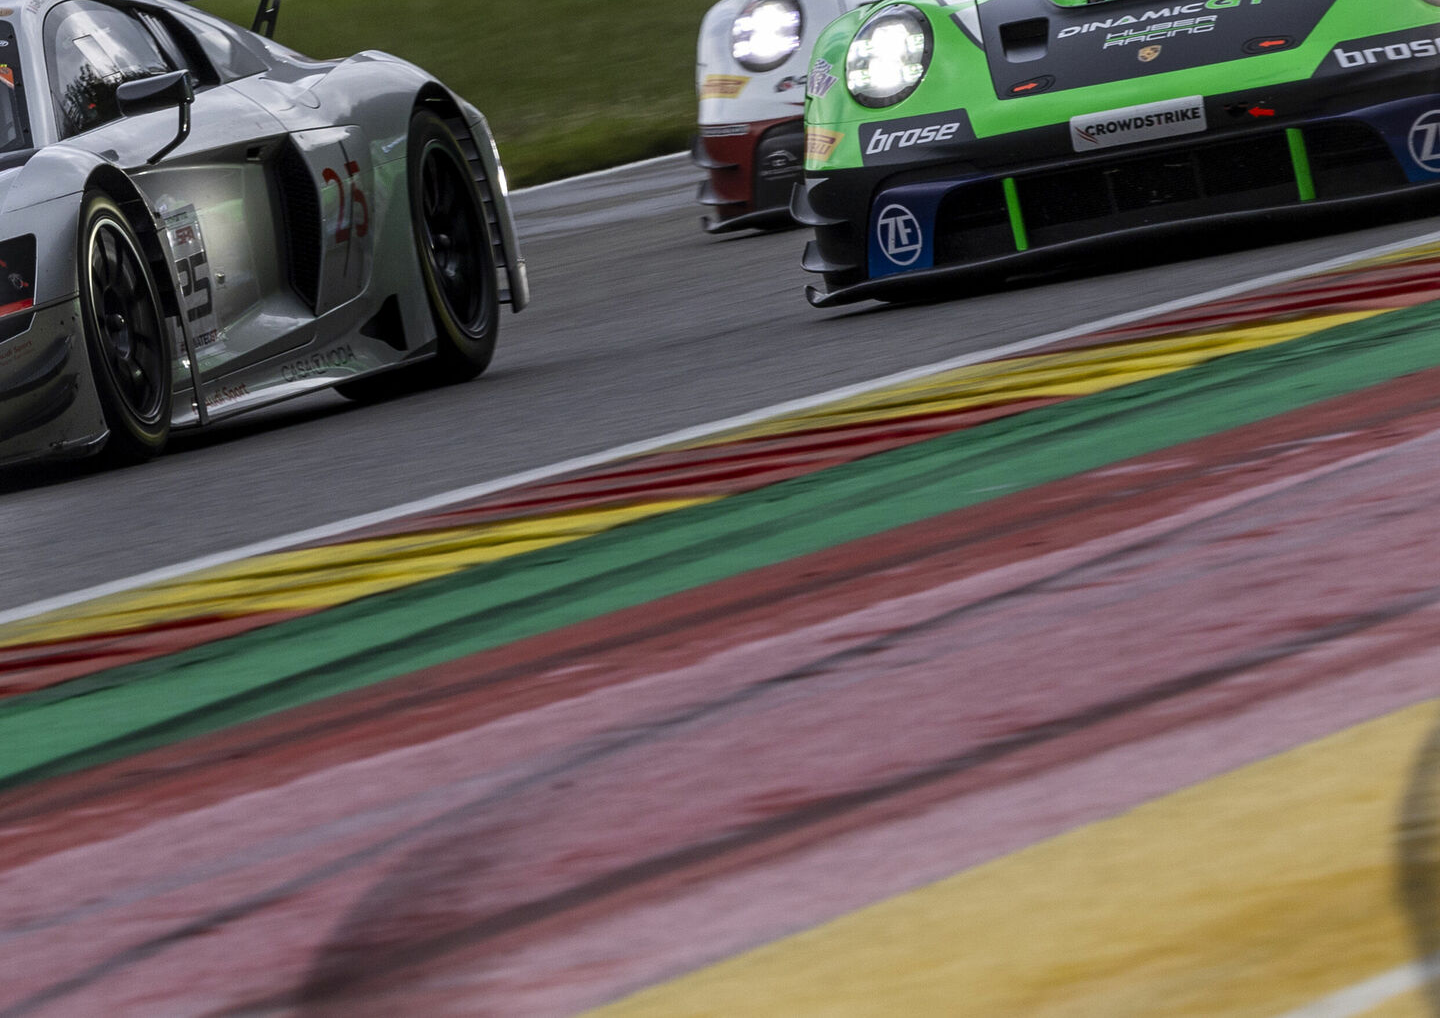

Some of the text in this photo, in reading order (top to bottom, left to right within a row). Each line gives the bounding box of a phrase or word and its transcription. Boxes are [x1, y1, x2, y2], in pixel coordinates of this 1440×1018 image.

[1103, 25, 1215, 50] RACING
[1106, 15, 1217, 40] HUBER
[1334, 37, 1440, 68] bros
[1084, 107, 1201, 137] CROWDSTRIKE
[866, 122, 960, 155] brose
[322, 161, 369, 244] 25
[879, 215, 921, 255] ZF
